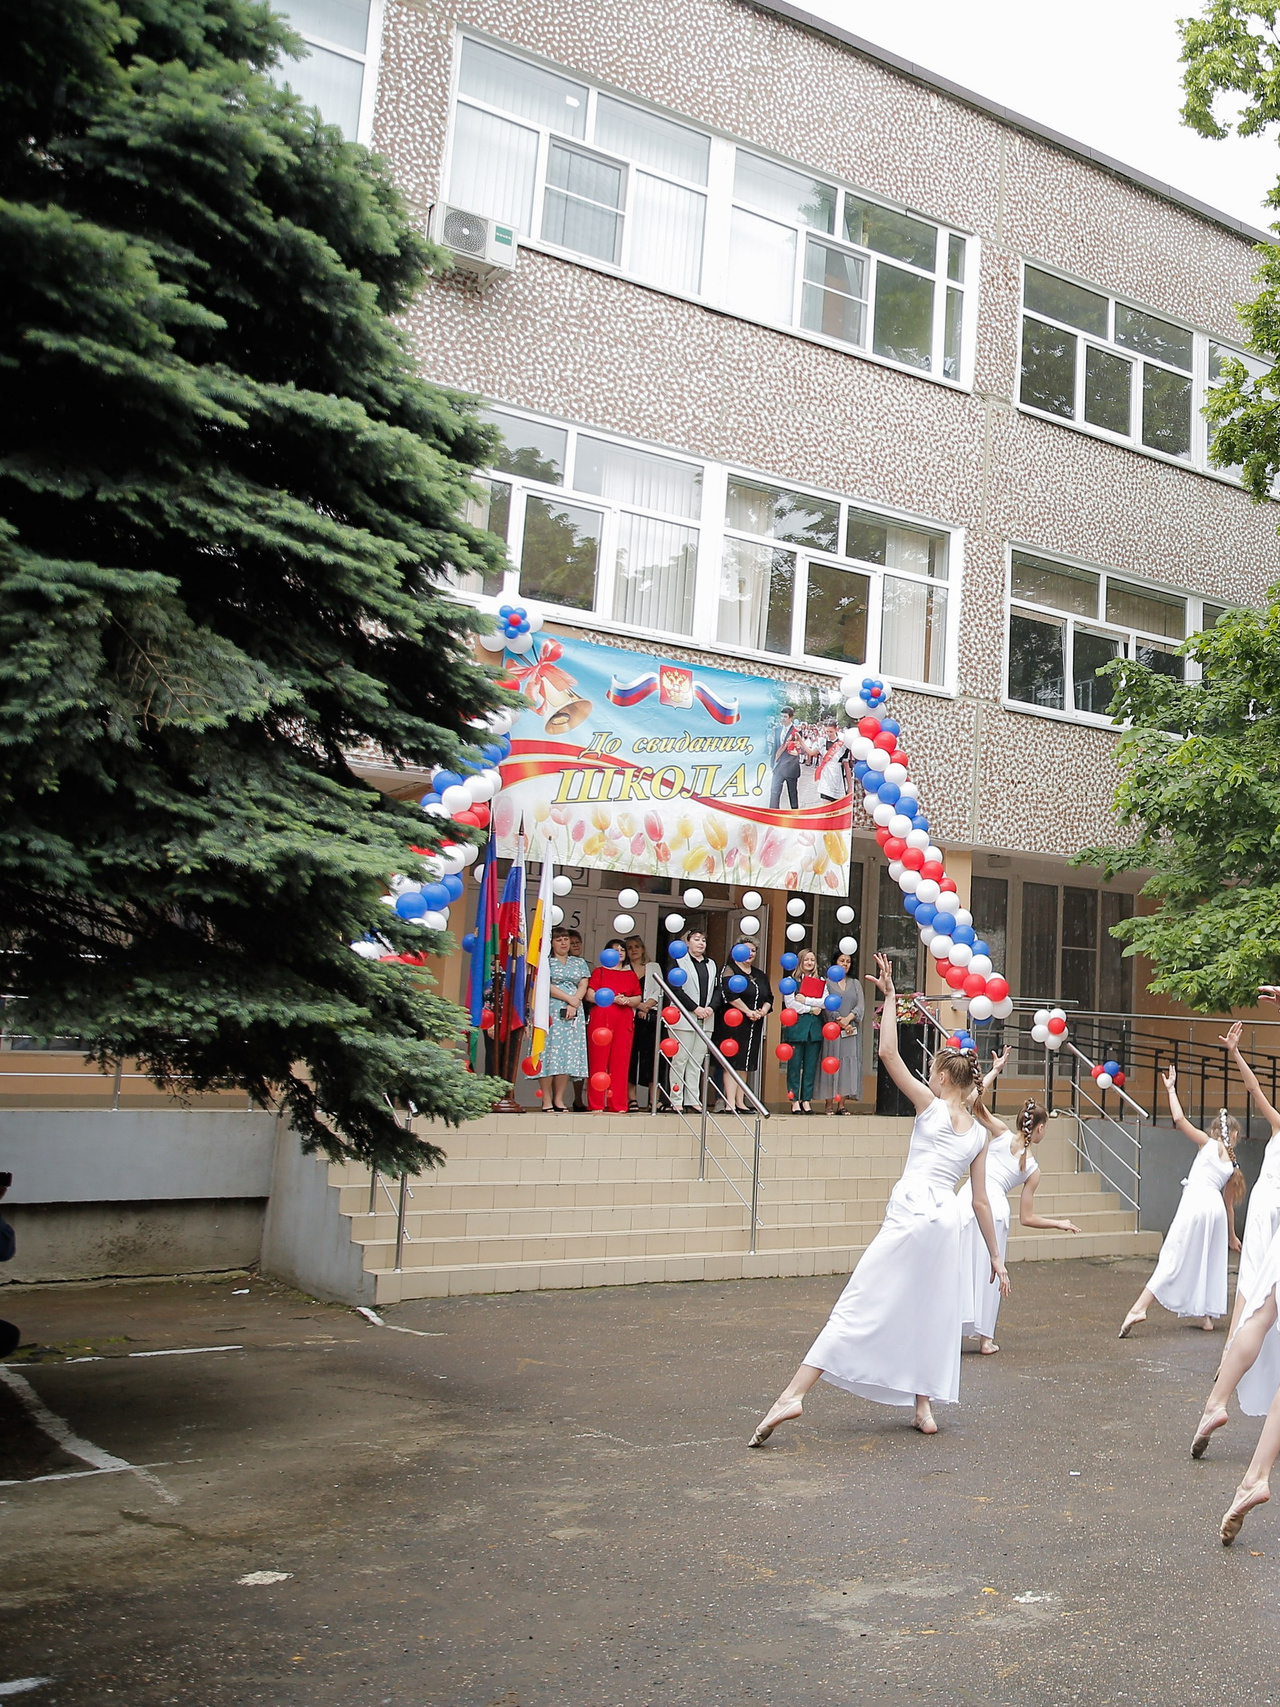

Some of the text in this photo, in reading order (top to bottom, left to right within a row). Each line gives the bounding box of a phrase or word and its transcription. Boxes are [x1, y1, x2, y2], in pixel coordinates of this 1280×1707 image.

[578, 730, 754, 760] До свидания,
[551, 763, 767, 804] ШКОЛА!
